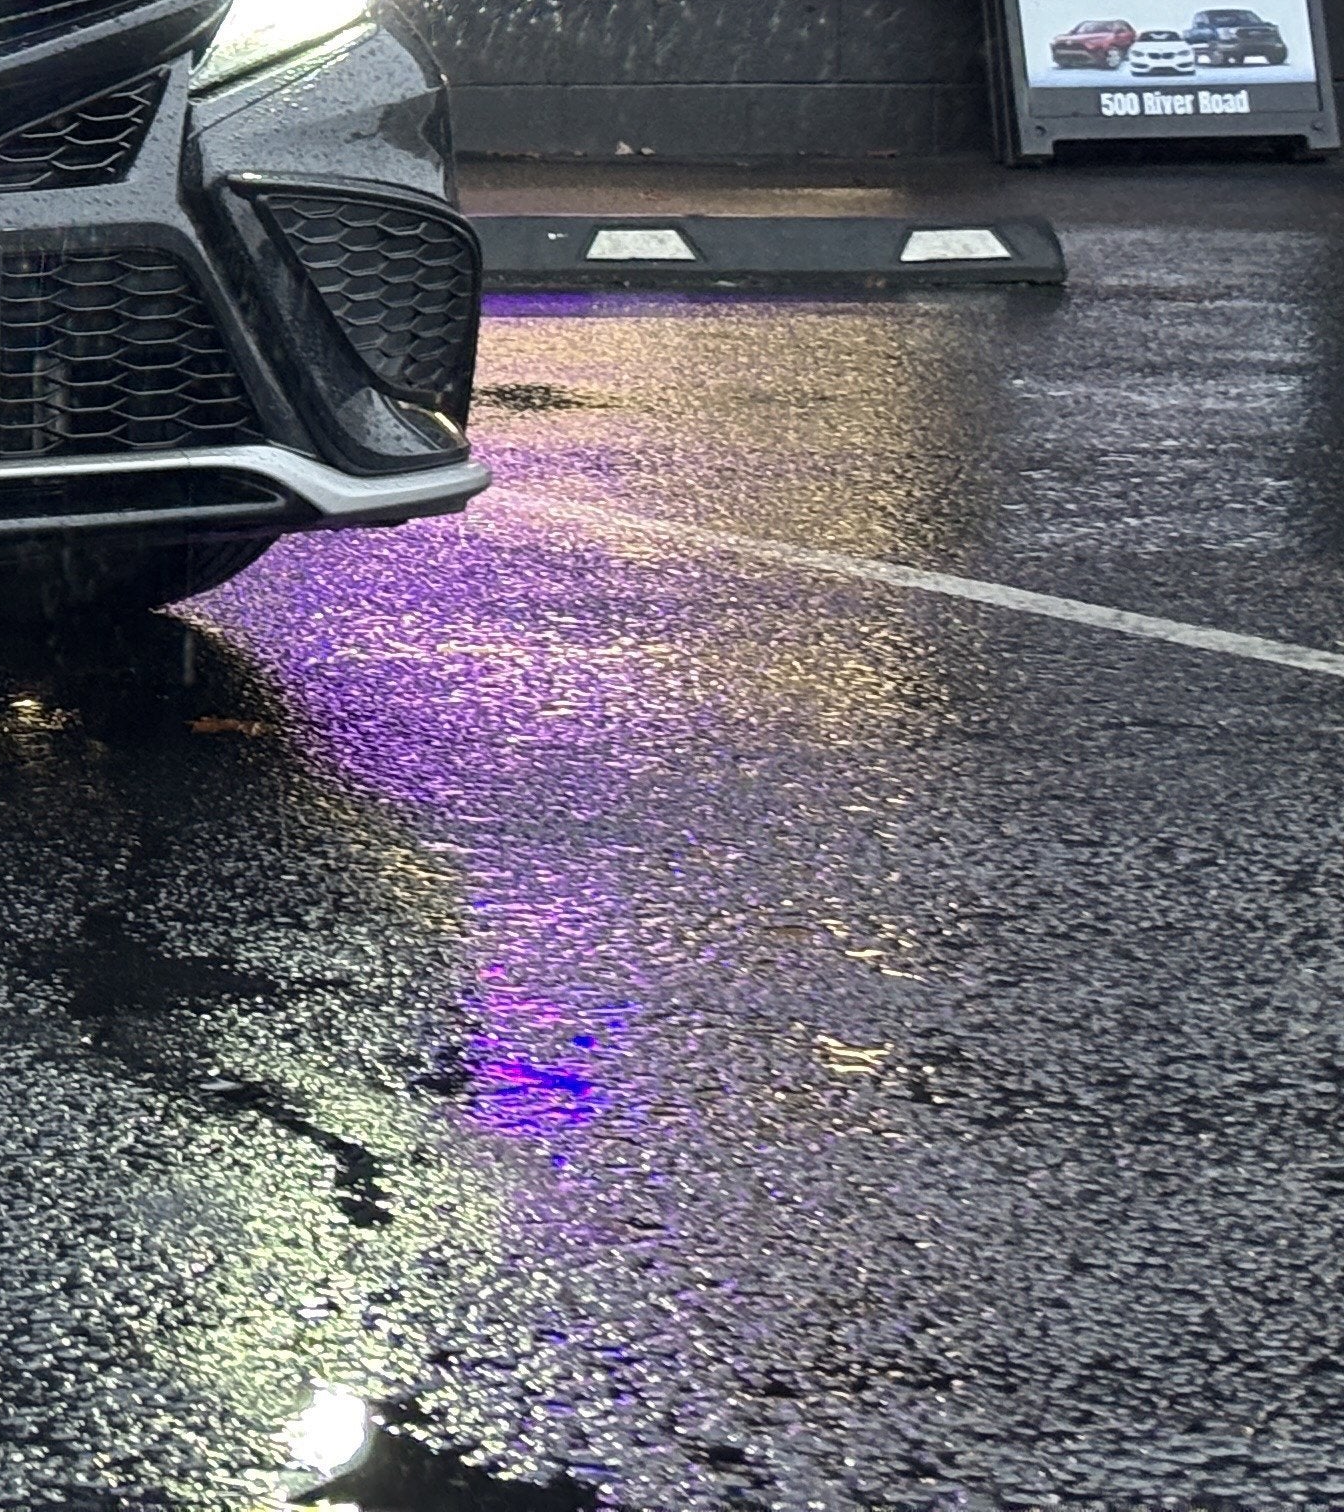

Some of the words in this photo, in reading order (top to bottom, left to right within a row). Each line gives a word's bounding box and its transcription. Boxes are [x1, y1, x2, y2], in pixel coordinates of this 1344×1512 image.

[1100, 92, 1141, 116] 500
[1142, 90, 1195, 115] River
[1197, 89, 1251, 114] Road
